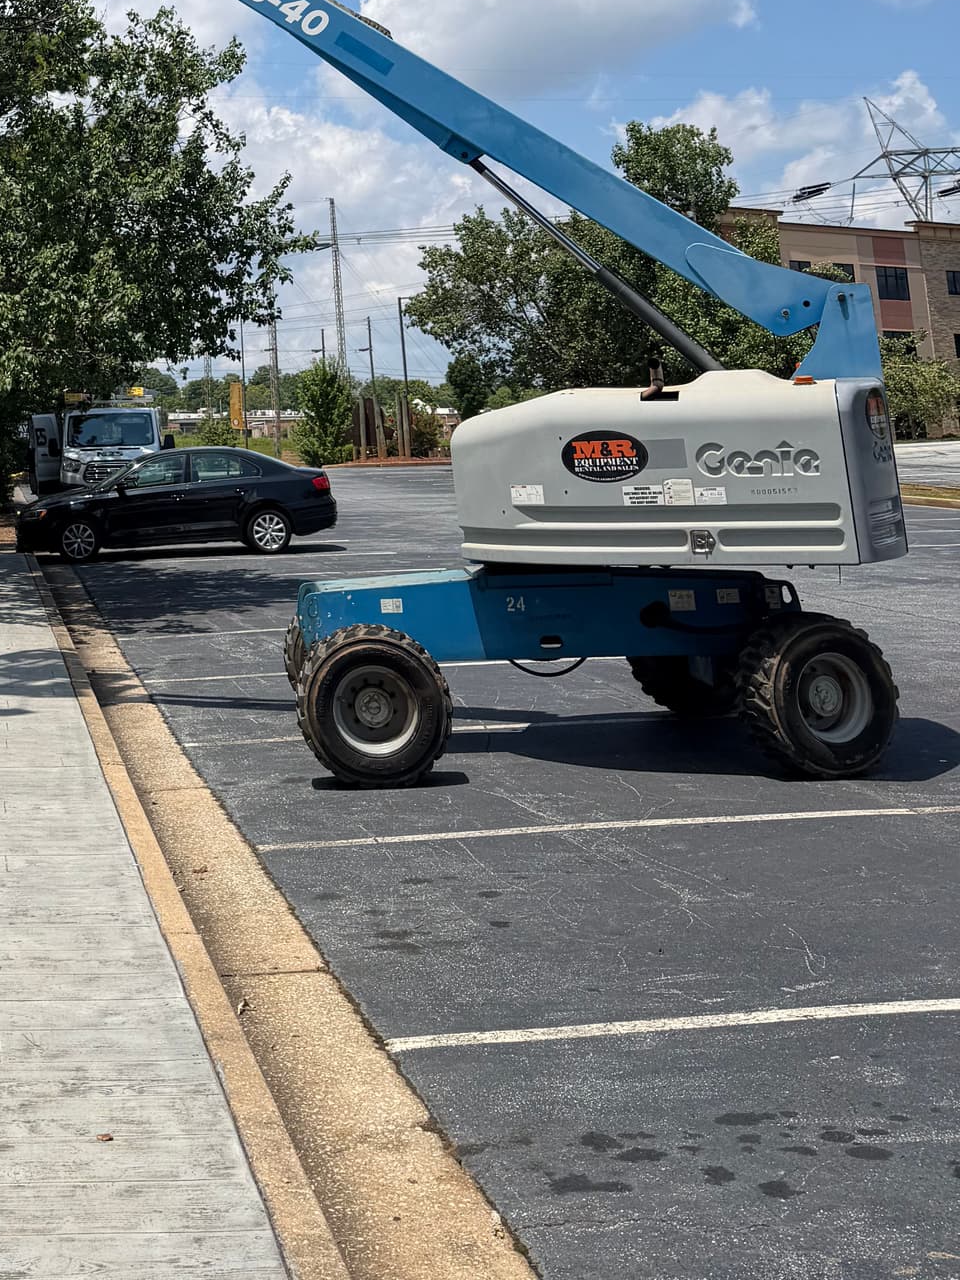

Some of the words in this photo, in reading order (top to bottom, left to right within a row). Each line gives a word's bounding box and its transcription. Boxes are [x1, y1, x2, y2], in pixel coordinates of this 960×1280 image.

[572, 439, 636, 458] M&R
[574, 457, 638, 467] EQUIPMENT
[695, 440, 820, 477] Genie
[506, 596, 526, 612] 24
